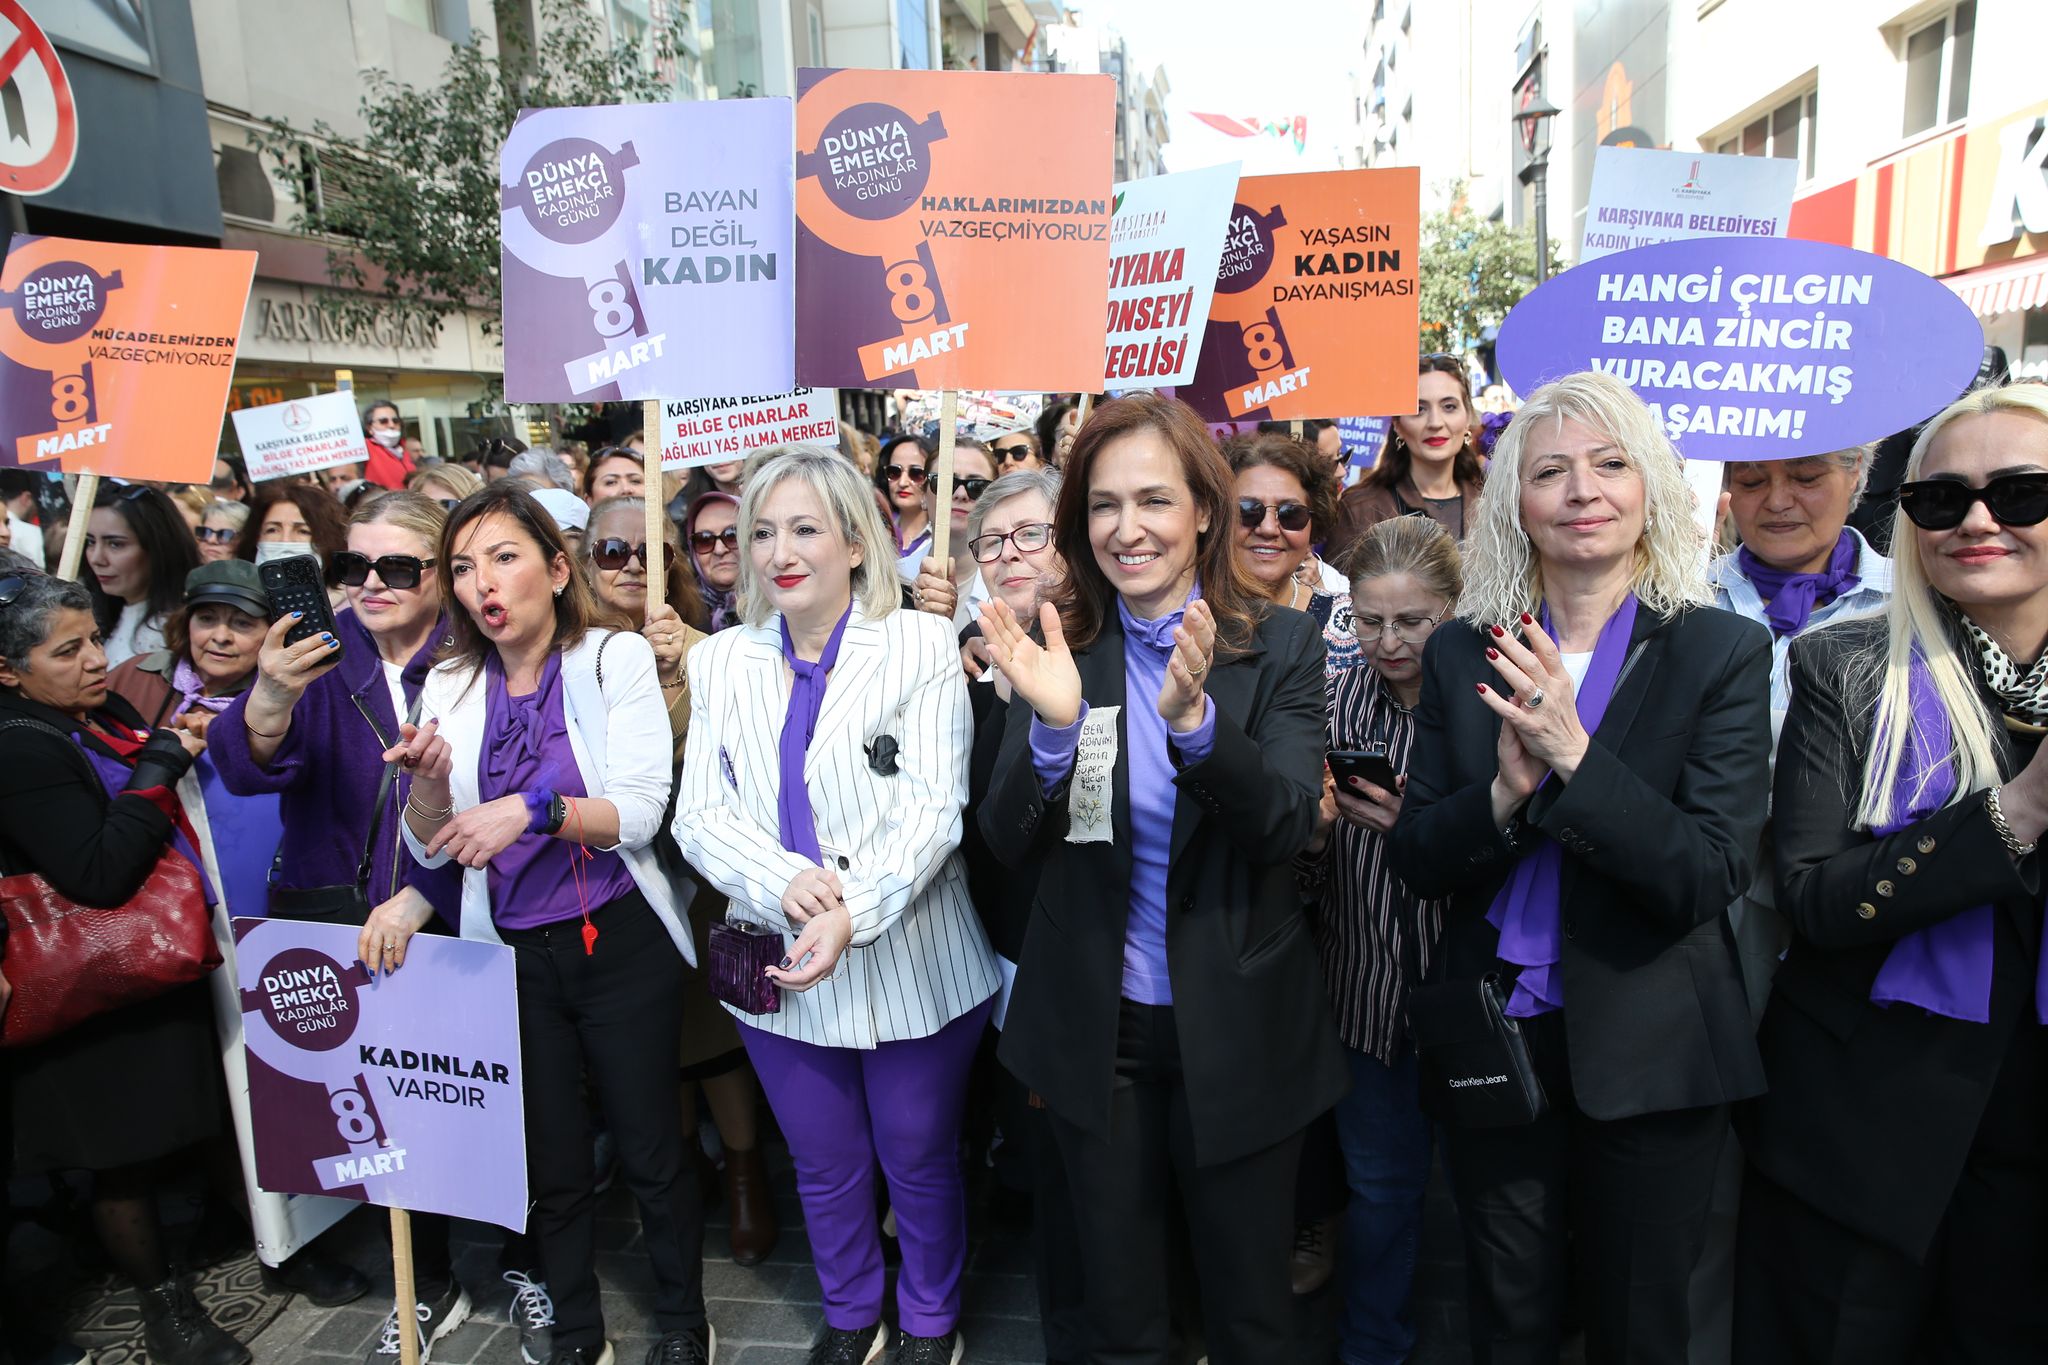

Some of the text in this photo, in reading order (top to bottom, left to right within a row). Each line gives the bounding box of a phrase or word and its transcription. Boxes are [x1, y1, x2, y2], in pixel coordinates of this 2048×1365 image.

[823, 120, 908, 156] DÜNYA
[526, 152, 604, 188] DÜNYA
[829, 136, 912, 175] EMEKÇİ
[531, 165, 608, 205] EMEKÇİ
[834, 158, 918, 190] KADINLAR
[856, 176, 902, 200] GÜNÜ
[538, 185, 614, 218] KADINLAR
[557, 203, 600, 227] GÜNÜ
[664, 188, 758, 214] BAYAN
[921, 196, 1106, 215] HAKLARIMIZDAN
[670, 219, 758, 249] DEĞİL,
[919, 219, 1108, 242] VAZGEÇMİYORUZ
[1300, 225, 1391, 246] YAŞASIN
[1597, 206, 1777, 236] KARŞIYAKA BELEDİYESİ
[1219, 243, 1264, 267] DINLAR
[1223, 226, 1259, 253] EKÇİ
[1585, 232, 1630, 250] KADIN
[643, 252, 777, 285] KADIN
[1108, 247, 1186, 289] IYAKA
[1217, 259, 1252, 280] GÜNÜ
[1294, 249, 1400, 277] KADIN
[24, 273, 94, 296] DÜNYA
[25, 285, 94, 310] EMEKÇİ
[885, 258, 935, 324] 8
[1272, 279, 1414, 302] DAYANIŞMASI
[1597, 265, 1873, 312] HANGİ ÇILGIN
[26, 301, 97, 320] KADINLAR
[41, 314, 81, 330] GÜNÜ
[587, 277, 636, 339] 8
[1106, 285, 1194, 334] ONSEYİ
[91, 328, 235, 348] MÜCADELEMİZDEN
[1601, 309, 1853, 350] BANA ZİNCİR
[88, 346, 232, 367] VAZGEÇMİYORUZ
[587, 333, 666, 384] MART
[882, 322, 969, 372] MART
[1105, 332, 1189, 379] ECLİSİ
[1242, 321, 1284, 372] 8
[1243, 367, 1311, 409] MART
[1590, 357, 1854, 404] VURACAKMIŞ
[51, 374, 89, 422] 8
[665, 397, 738, 418] KARŞIYAKA
[677, 403, 809, 438] BİLGE ÇINARLAR
[716, 436, 739, 454] YAŞ
[743, 430, 779, 449] ALMA
[782, 416, 836, 443] MERKEZİ
[1338, 428, 1365, 442] RDIM
[1648, 403, 1806, 440] AŞARIM!
[36, 423, 112, 458] MART
[263, 448, 293, 463] BİLGE
[1083, 723, 1104, 736] BEN
[1077, 748, 1108, 763] Senin
[263, 965, 338, 992] DÜNYA
[269, 978, 343, 1010] EMEKÇİ
[276, 1000, 349, 1023] KADINLAR
[296, 1014, 337, 1033] GÜNÜ
[359, 1045, 510, 1084] KADINLAR
[1485, 1074, 1508, 1084] Jeans
[387, 1075, 486, 1109] VARDIR
[329, 1087, 376, 1145] 8
[335, 1148, 407, 1182] MART
